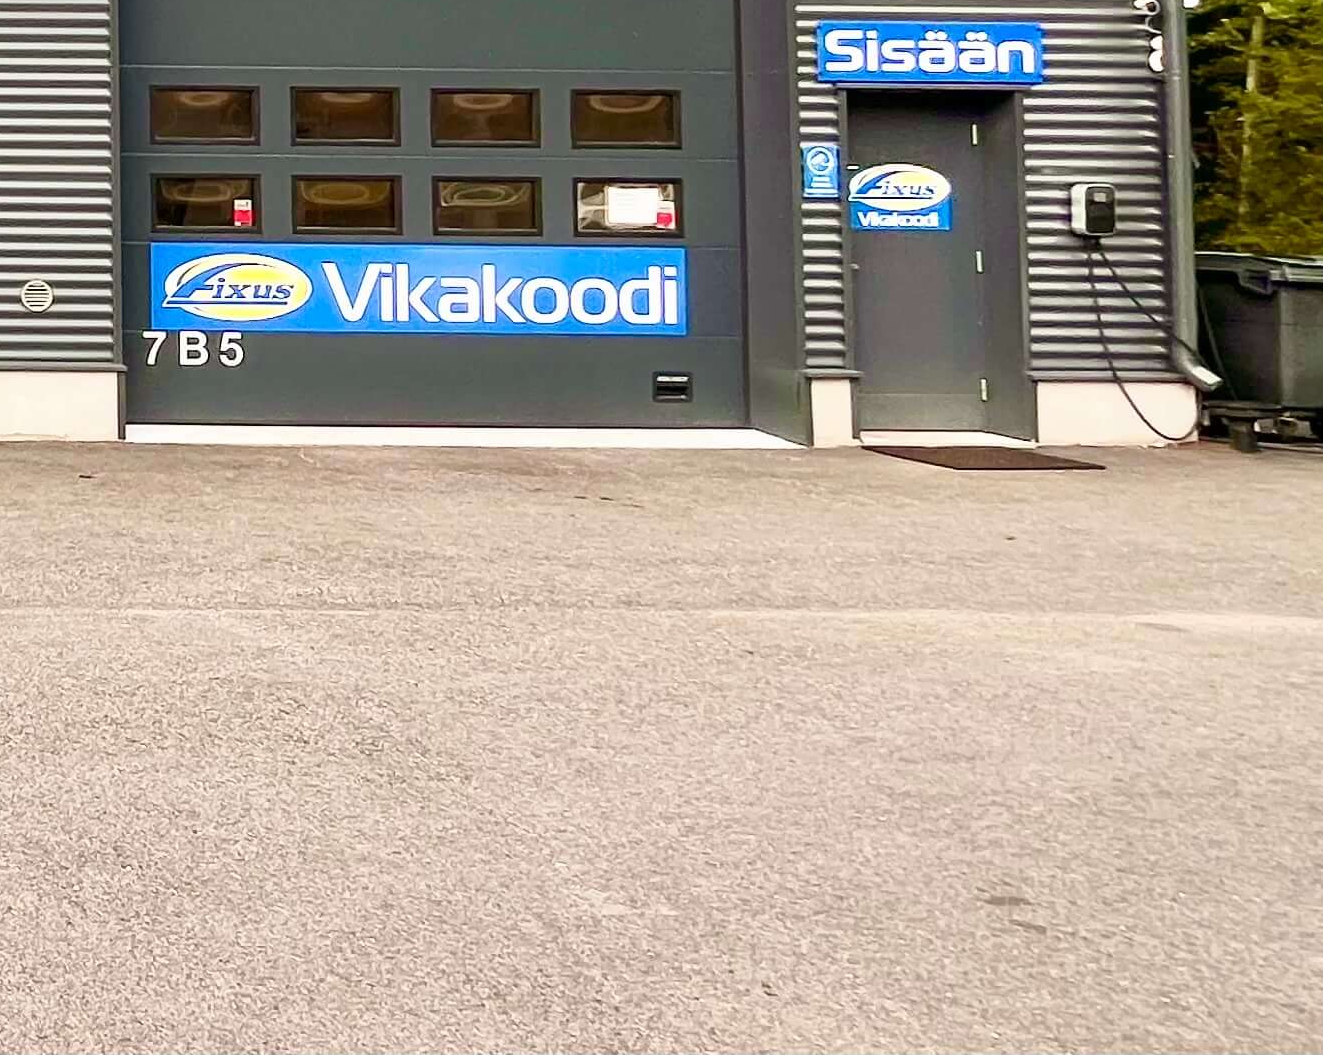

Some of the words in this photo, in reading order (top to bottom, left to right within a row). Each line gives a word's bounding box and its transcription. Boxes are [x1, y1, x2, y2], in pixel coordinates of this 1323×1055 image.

[824, 29, 1035, 73] Sisään
[854, 171, 937, 196] Fixus
[170, 262, 294, 300] Fixus
[321, 262, 679, 325] Vikakoodi
